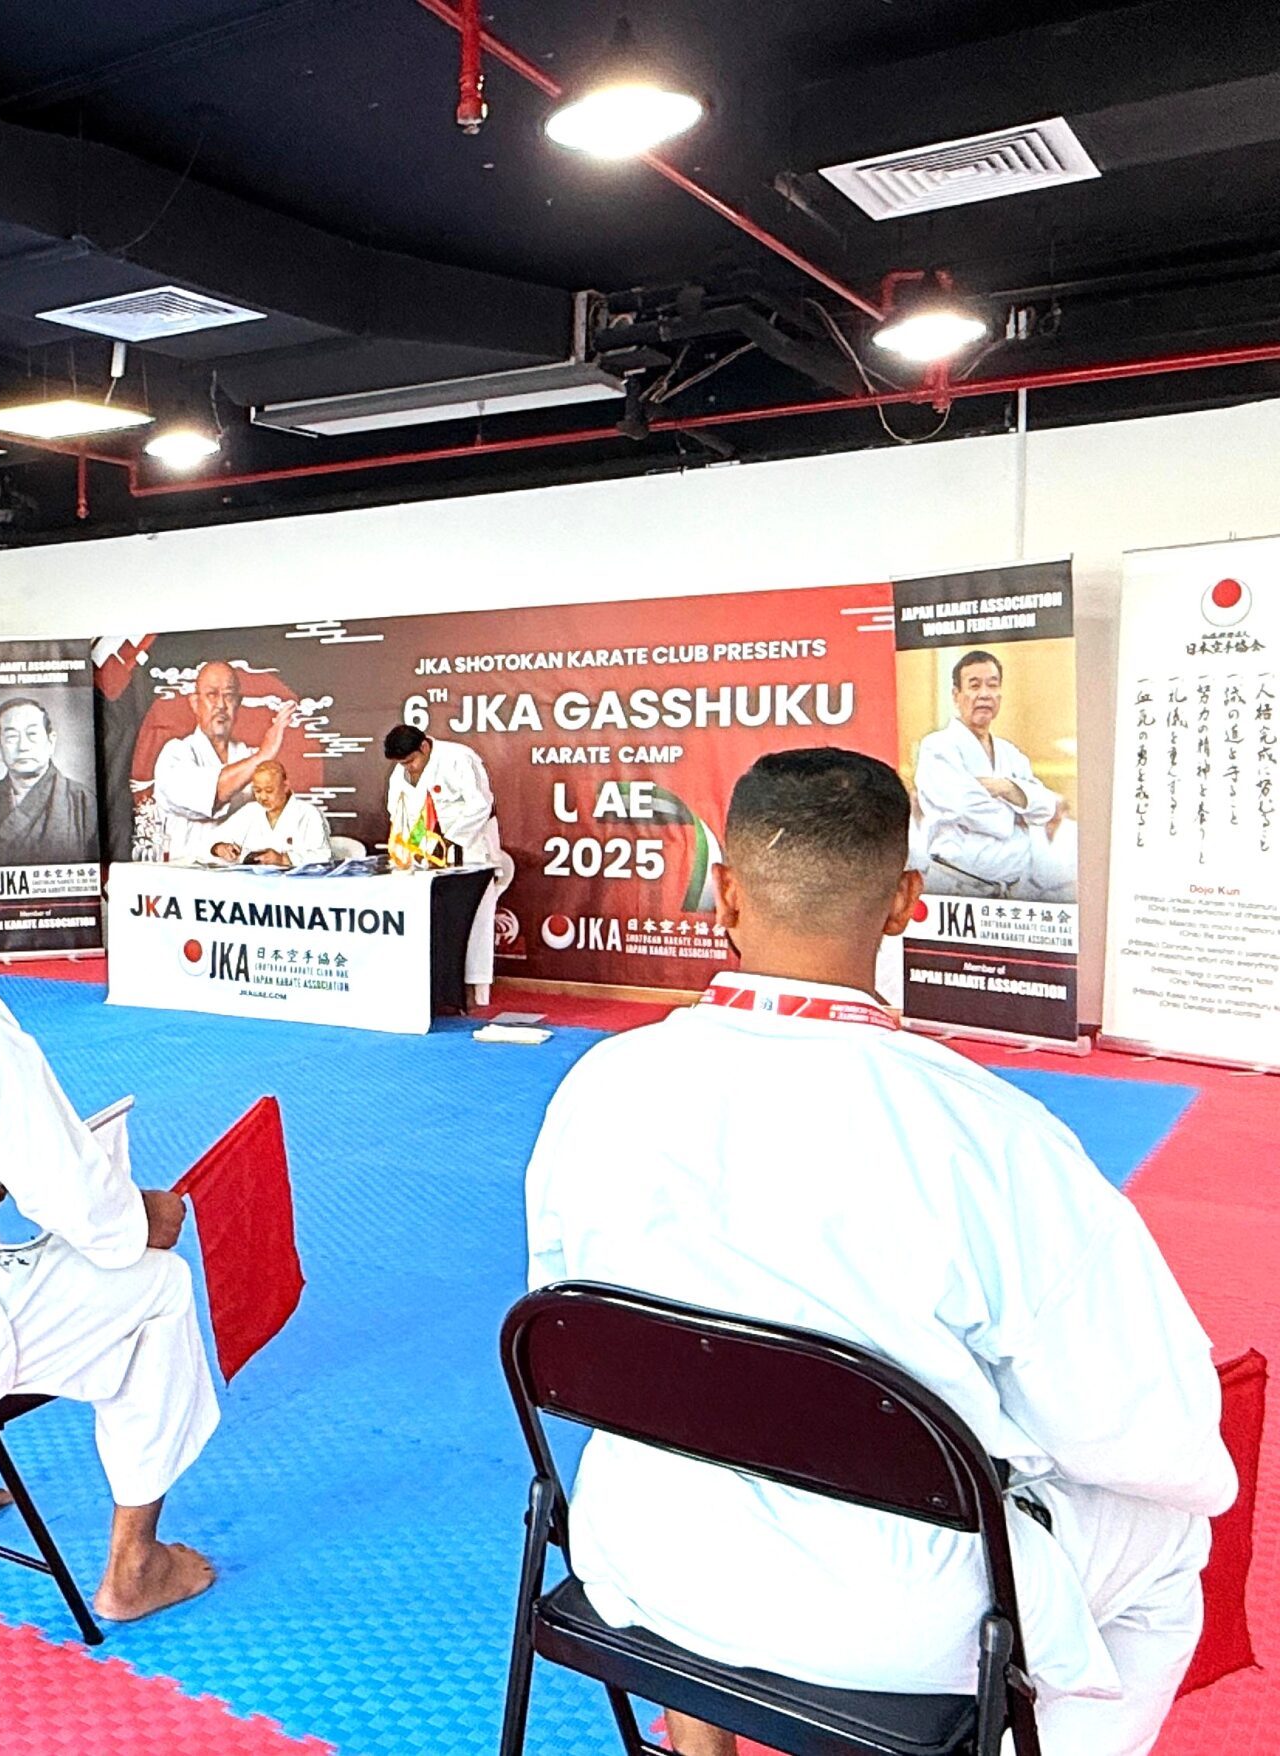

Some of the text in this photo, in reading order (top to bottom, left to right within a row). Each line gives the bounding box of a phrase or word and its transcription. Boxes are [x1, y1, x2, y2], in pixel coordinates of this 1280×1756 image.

[902, 591, 1062, 621] JAPAN KARATE ASSOCIATION
[922, 613, 1036, 637] WORLD FEDERATION
[414, 638, 827, 676] JKA SHOTOKAN KARATE CLUB PRESENTS
[449, 693, 543, 732] JKA
[553, 682, 854, 730] GASSHUKU
[531, 745, 684, 765] KARATE CAMP
[543, 836, 666, 880] 2025
[1189, 884, 1240, 896] Dojo Kun
[130, 894, 406, 936] JKA EXAMINATION
[937, 901, 977, 939] JKA
[981, 905, 1072, 924] 日本空手協会
[576, 917, 623, 952] JKA
[1001, 932, 1025, 943] KARATE
[1028, 934, 1073, 947] ASSOCIATION
[209, 941, 250, 982] JKA
[256, 947, 349, 967] 日本空手協会
[909, 968, 1067, 1000] JAPAN KARATE ASSOCIATION
